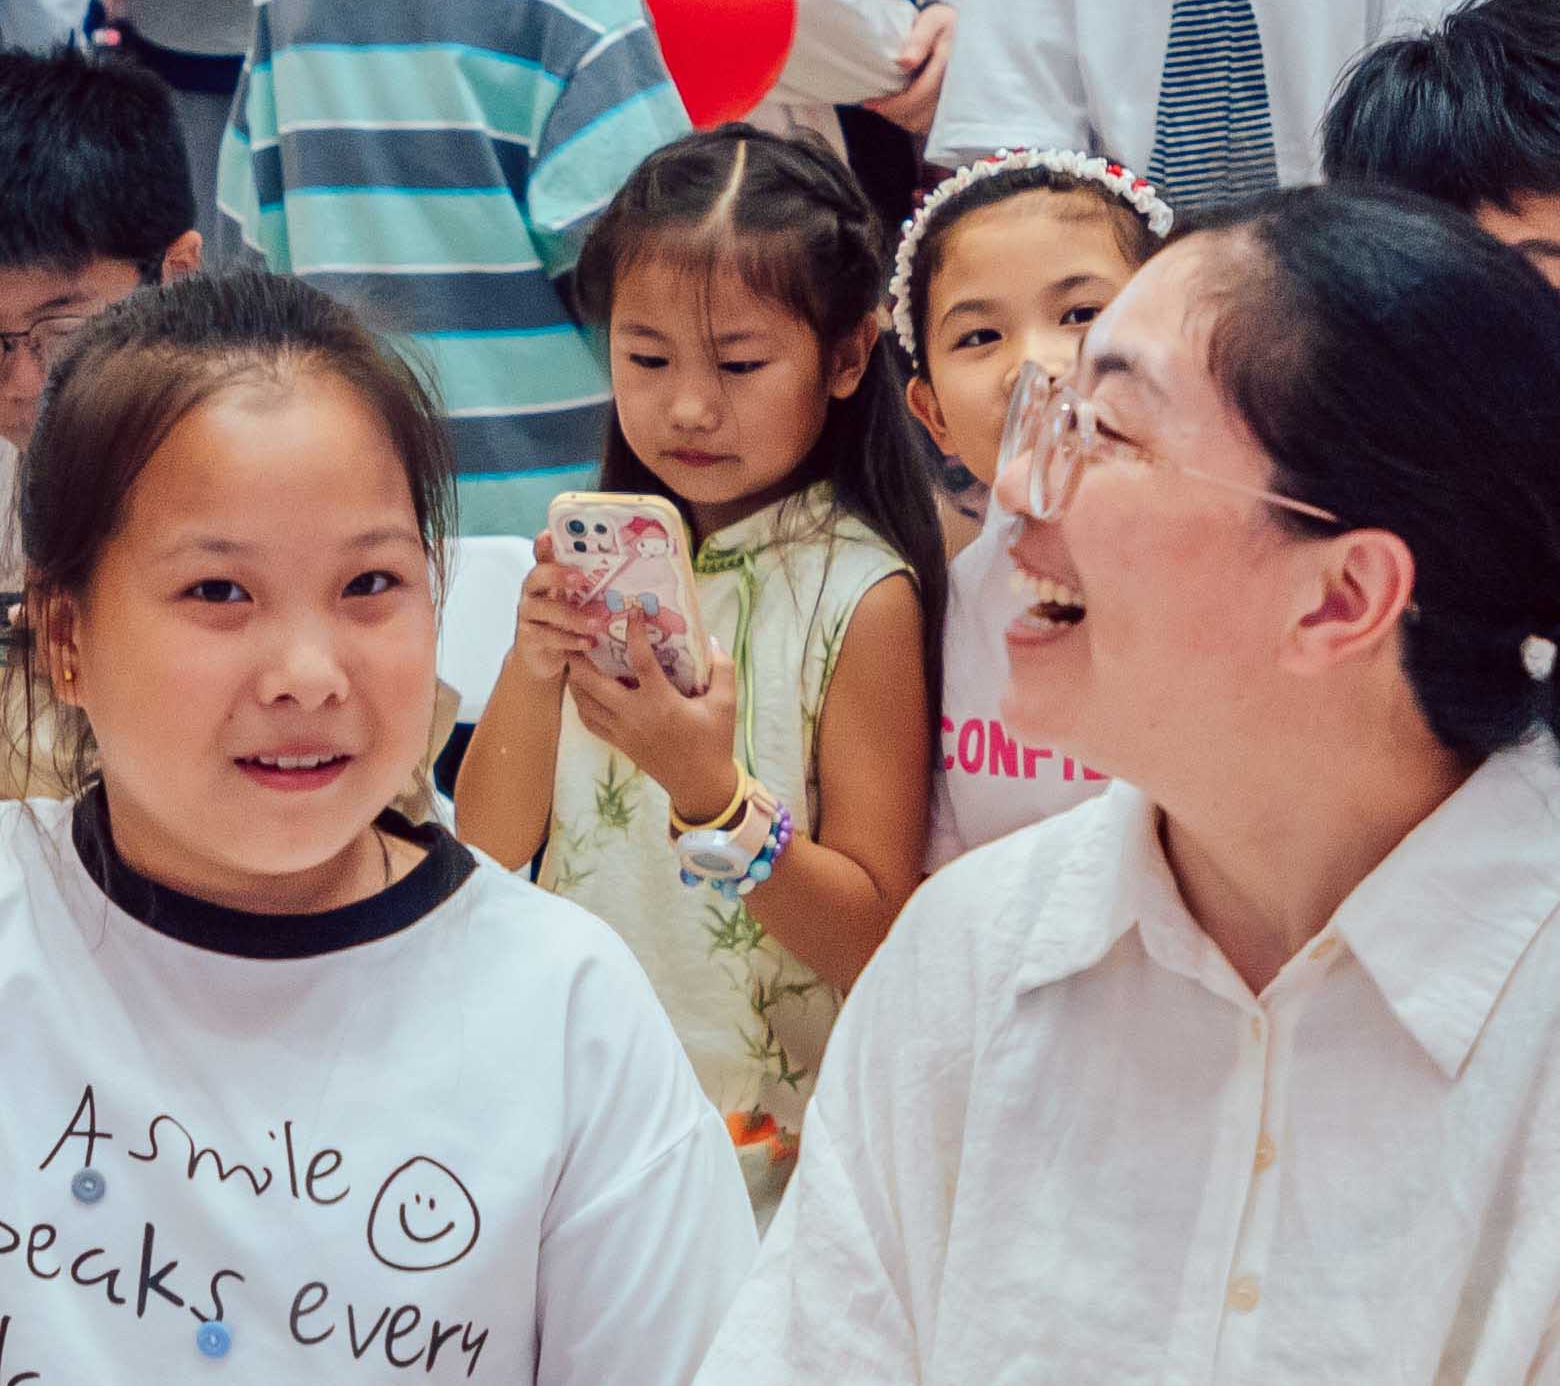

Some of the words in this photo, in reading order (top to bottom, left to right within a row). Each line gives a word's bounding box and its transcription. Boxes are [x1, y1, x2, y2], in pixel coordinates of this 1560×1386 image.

[39, 1084, 114, 1173] A
[128, 1113, 351, 1205] smile
[288, 1280, 490, 1378] every
